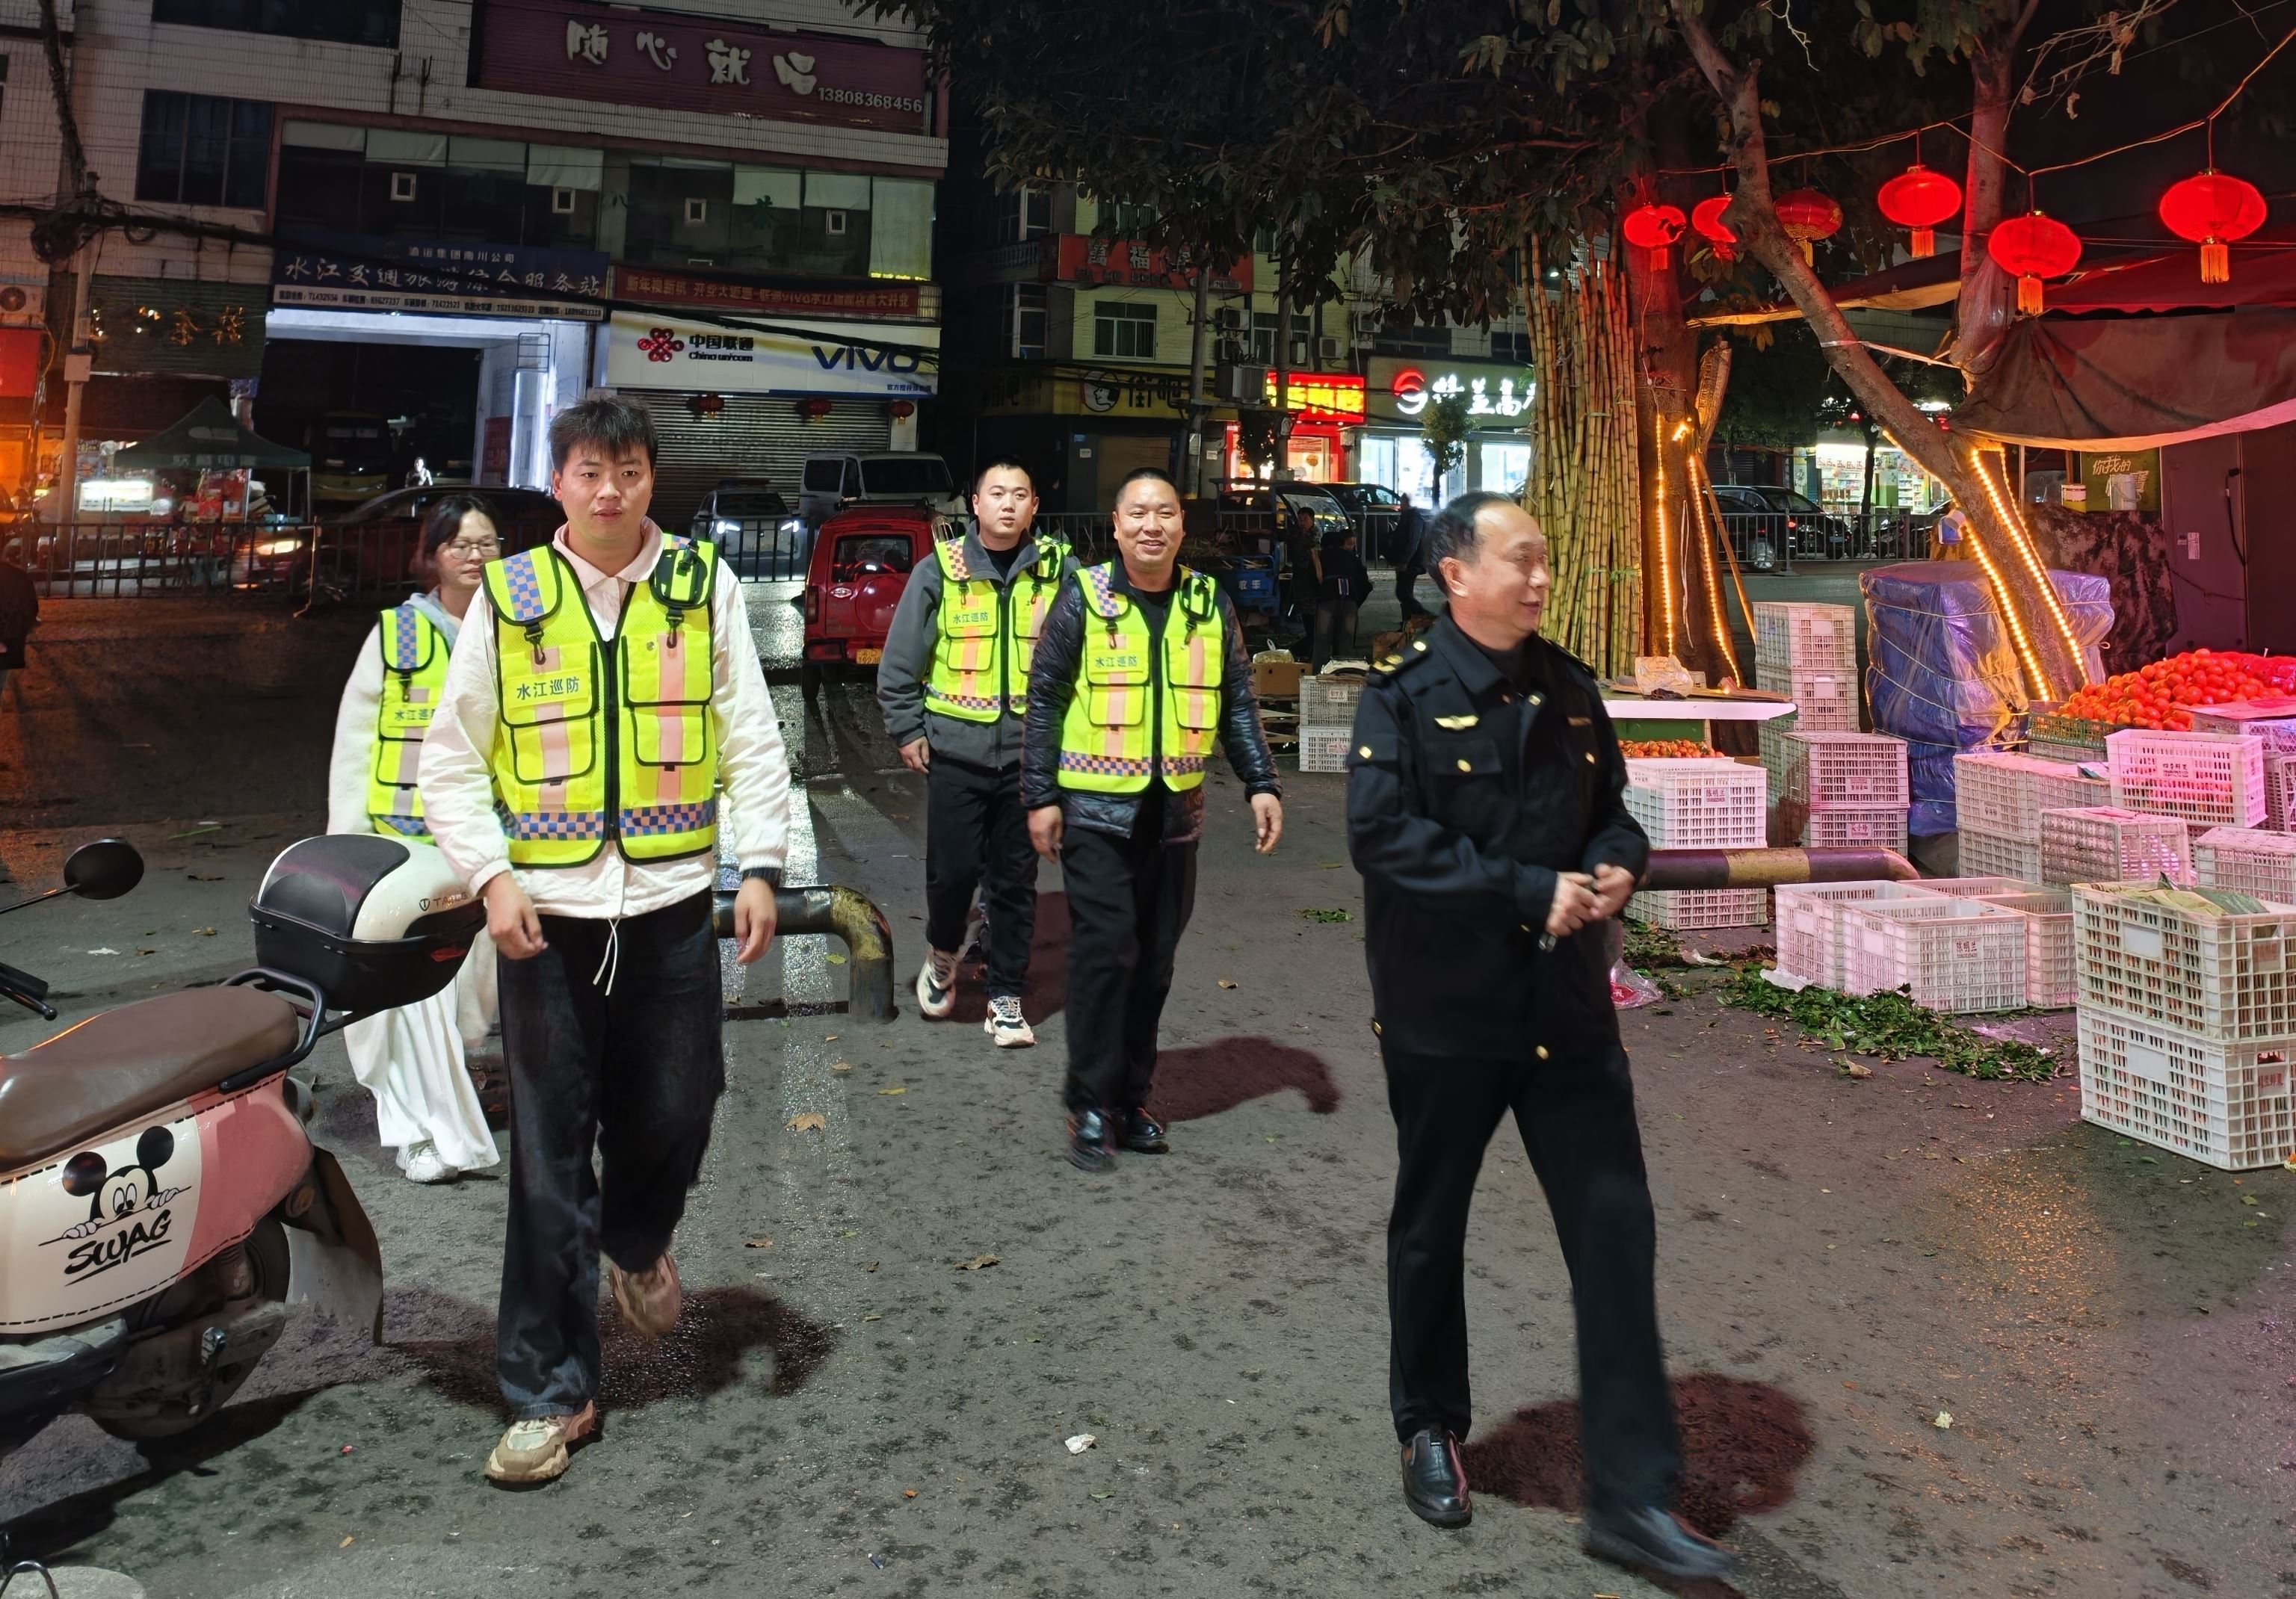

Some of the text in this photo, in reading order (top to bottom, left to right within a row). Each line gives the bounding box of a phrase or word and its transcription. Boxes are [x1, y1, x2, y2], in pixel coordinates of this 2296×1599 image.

[818, 87, 923, 114] 13808368456
[689, 334, 754, 352] 中国联通
[688, 351, 716, 362] China
[952, 612, 989, 625] 水江巡防
[1095, 655, 1138, 669] 水江巡防
[516, 675, 581, 701] 水江巡防
[1956, 941, 1978, 953] 陈明兰
[65, 1210, 171, 1275] SWAG
